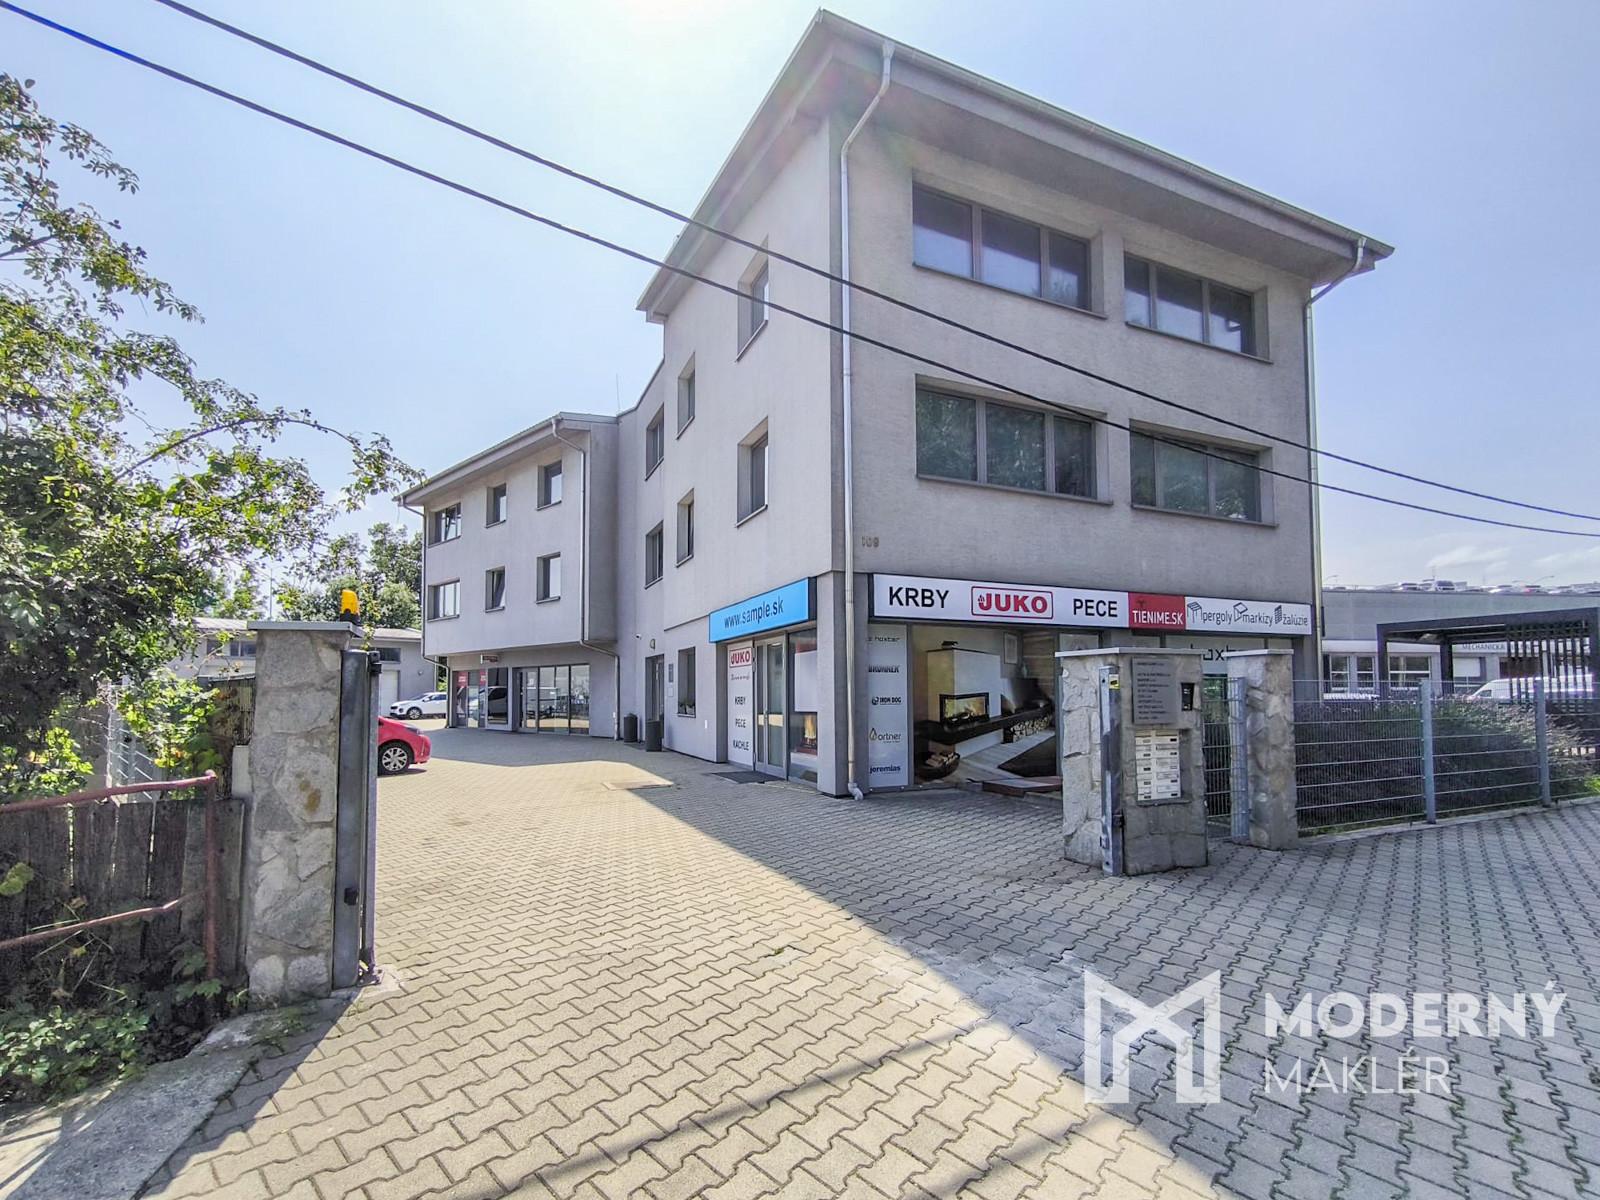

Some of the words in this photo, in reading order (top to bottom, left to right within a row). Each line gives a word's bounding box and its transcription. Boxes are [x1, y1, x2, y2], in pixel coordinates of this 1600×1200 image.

[889, 586, 949, 608] KRBY
[978, 593, 1048, 614] JUKO
[724, 596, 784, 629] www.sample.sk
[1073, 598, 1118, 617] PECE
[1132, 610, 1184, 625] TIENIME.SK
[1202, 610, 1233, 626] pergoly
[730, 651, 751, 665] JUKO
[878, 732, 902, 741] ortner
